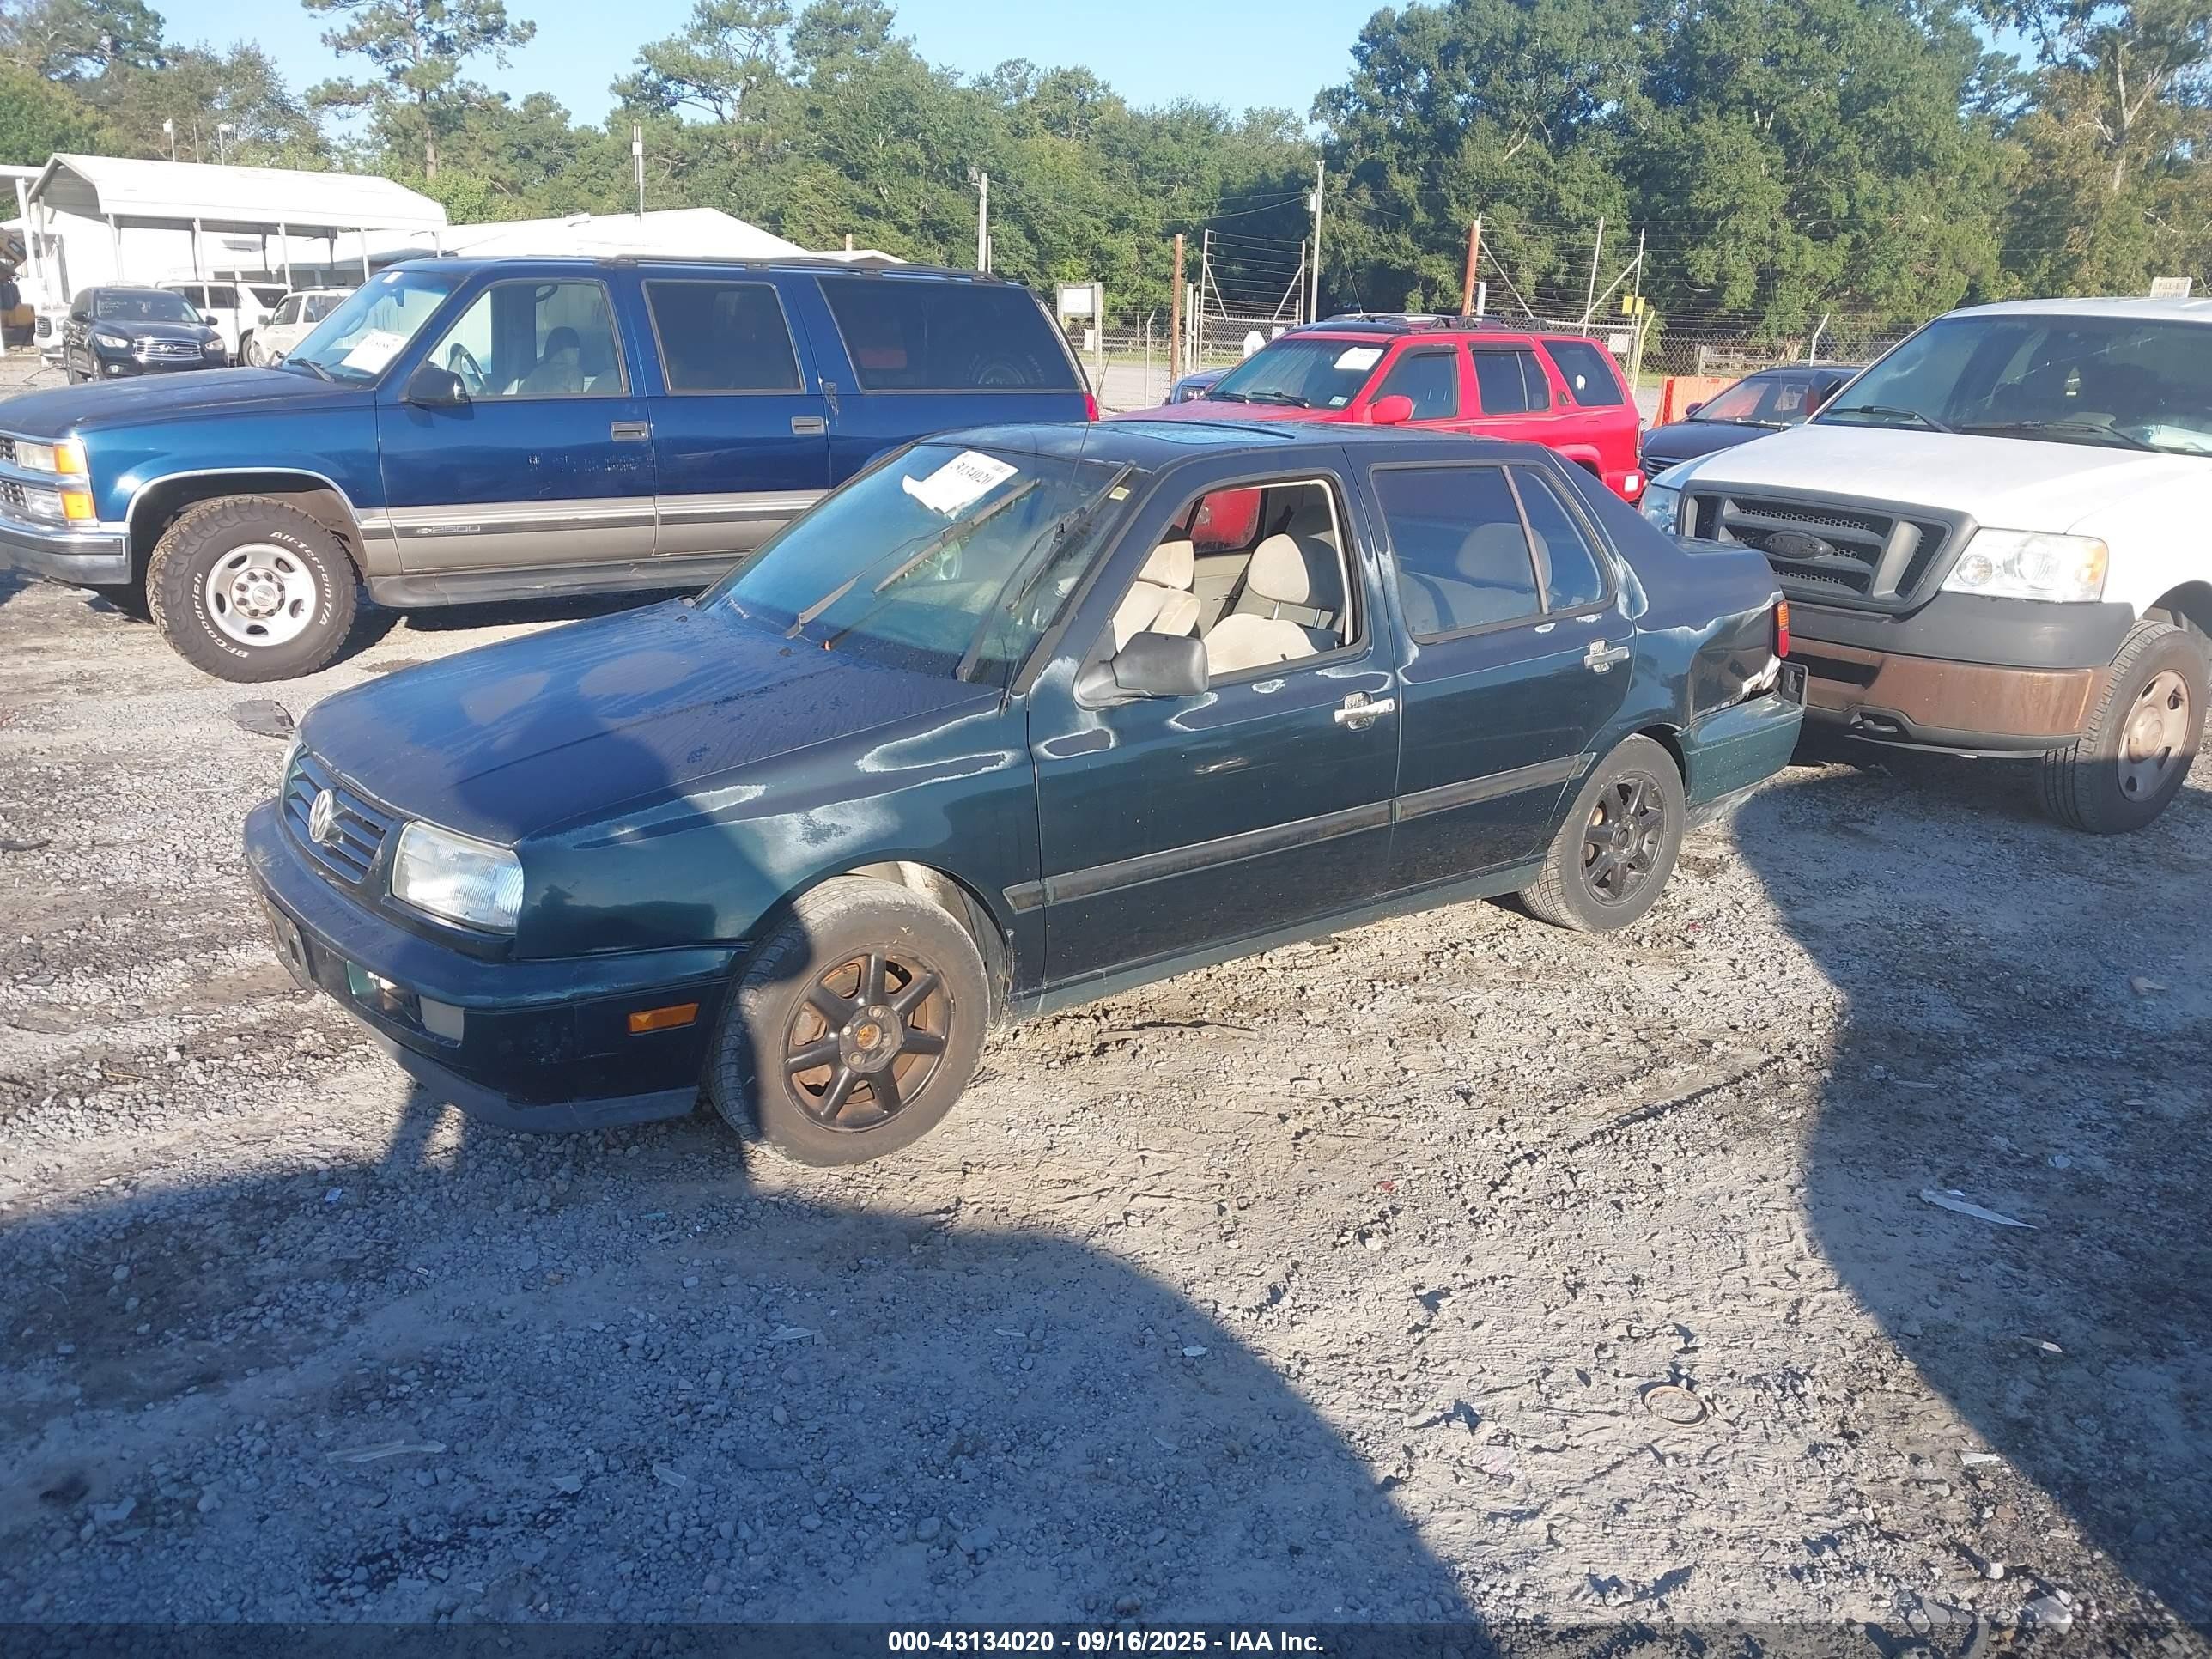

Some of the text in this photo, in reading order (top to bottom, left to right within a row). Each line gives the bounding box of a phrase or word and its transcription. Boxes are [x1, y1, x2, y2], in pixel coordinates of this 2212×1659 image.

[433, 525, 480, 533] 2500
[269, 531, 332, 599] All-Terrain
[192, 573, 250, 658] BFGoodrich
